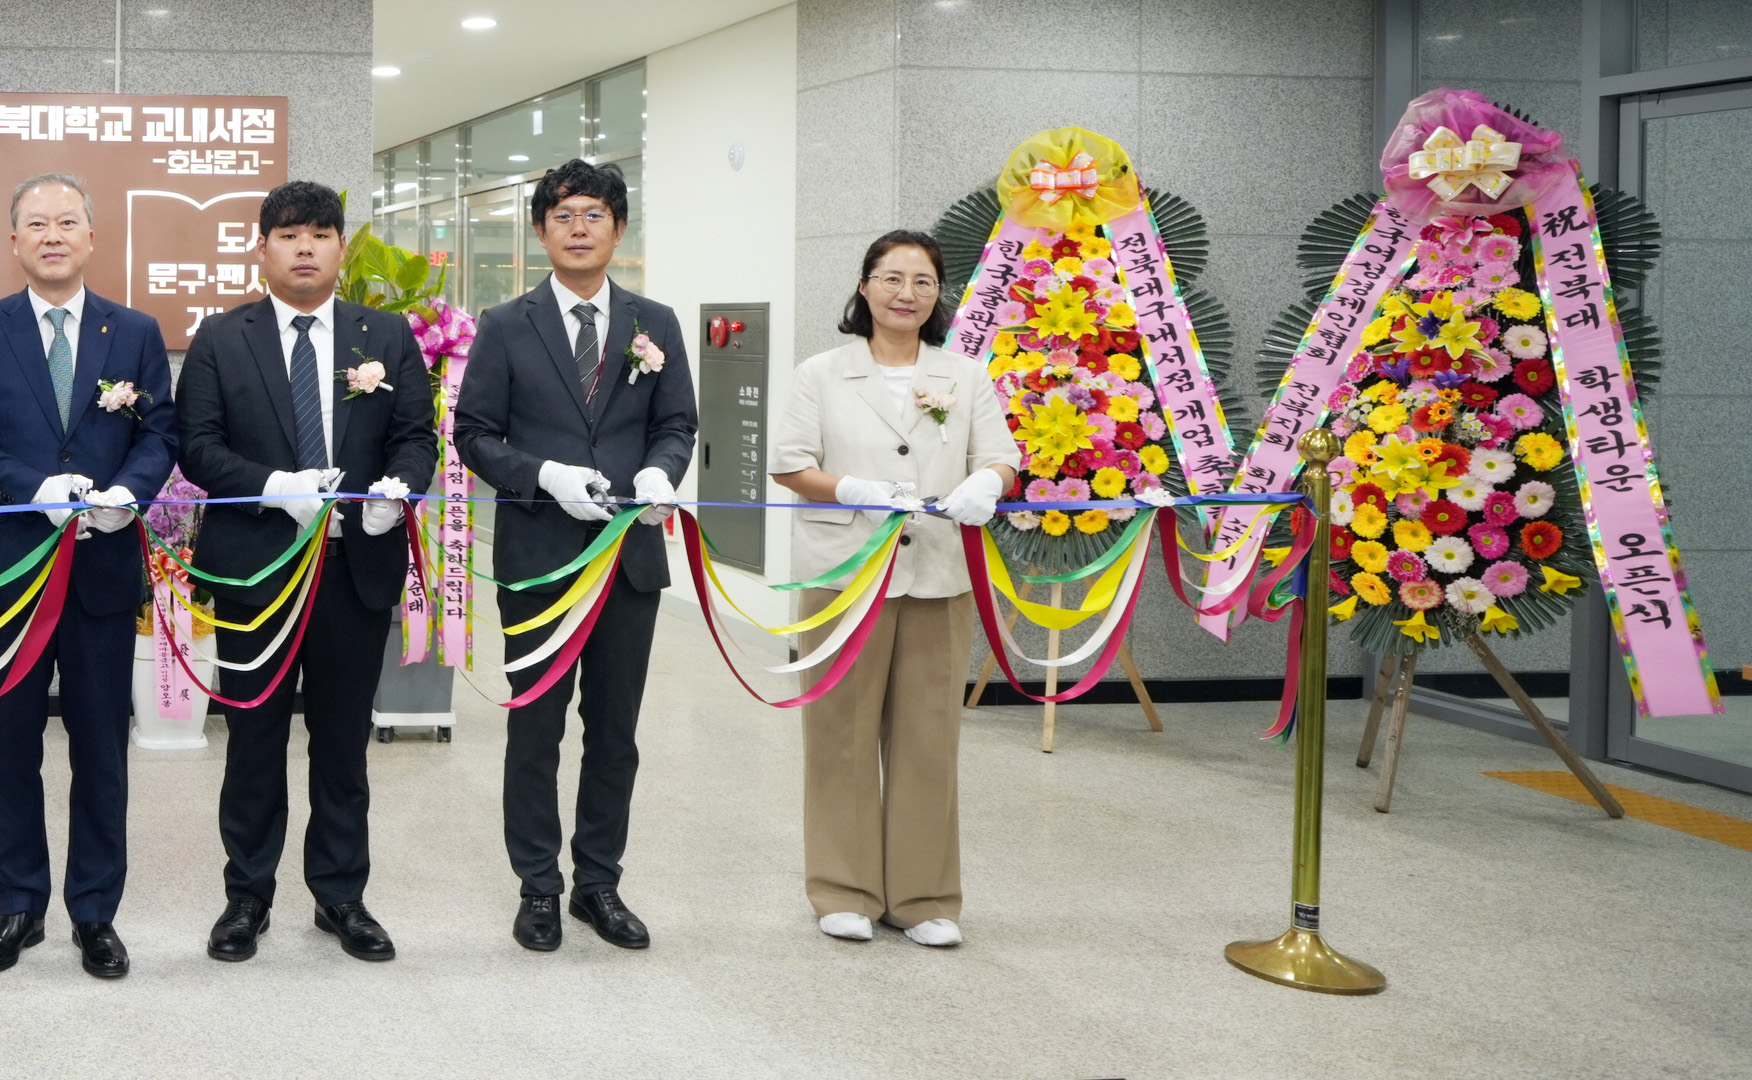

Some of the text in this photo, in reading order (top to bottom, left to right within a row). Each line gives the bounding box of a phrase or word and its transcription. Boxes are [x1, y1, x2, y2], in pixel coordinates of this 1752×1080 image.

[142, 107, 275, 144] 교내서점
[959, 239, 1025, 358] 한국출판협
[1305, 207, 1412, 366] 한국여성경제인협회
[739, 386, 759, 398] 소화전
[1174, 400, 1215, 448] 개업
[1264, 381, 1321, 452] 전북지회
[1542, 205, 1672, 630] 祝 전북대 학생타운 오픈식
[446, 493, 468, 532] 오픈을
[445, 540, 468, 620] 축하드립니다
